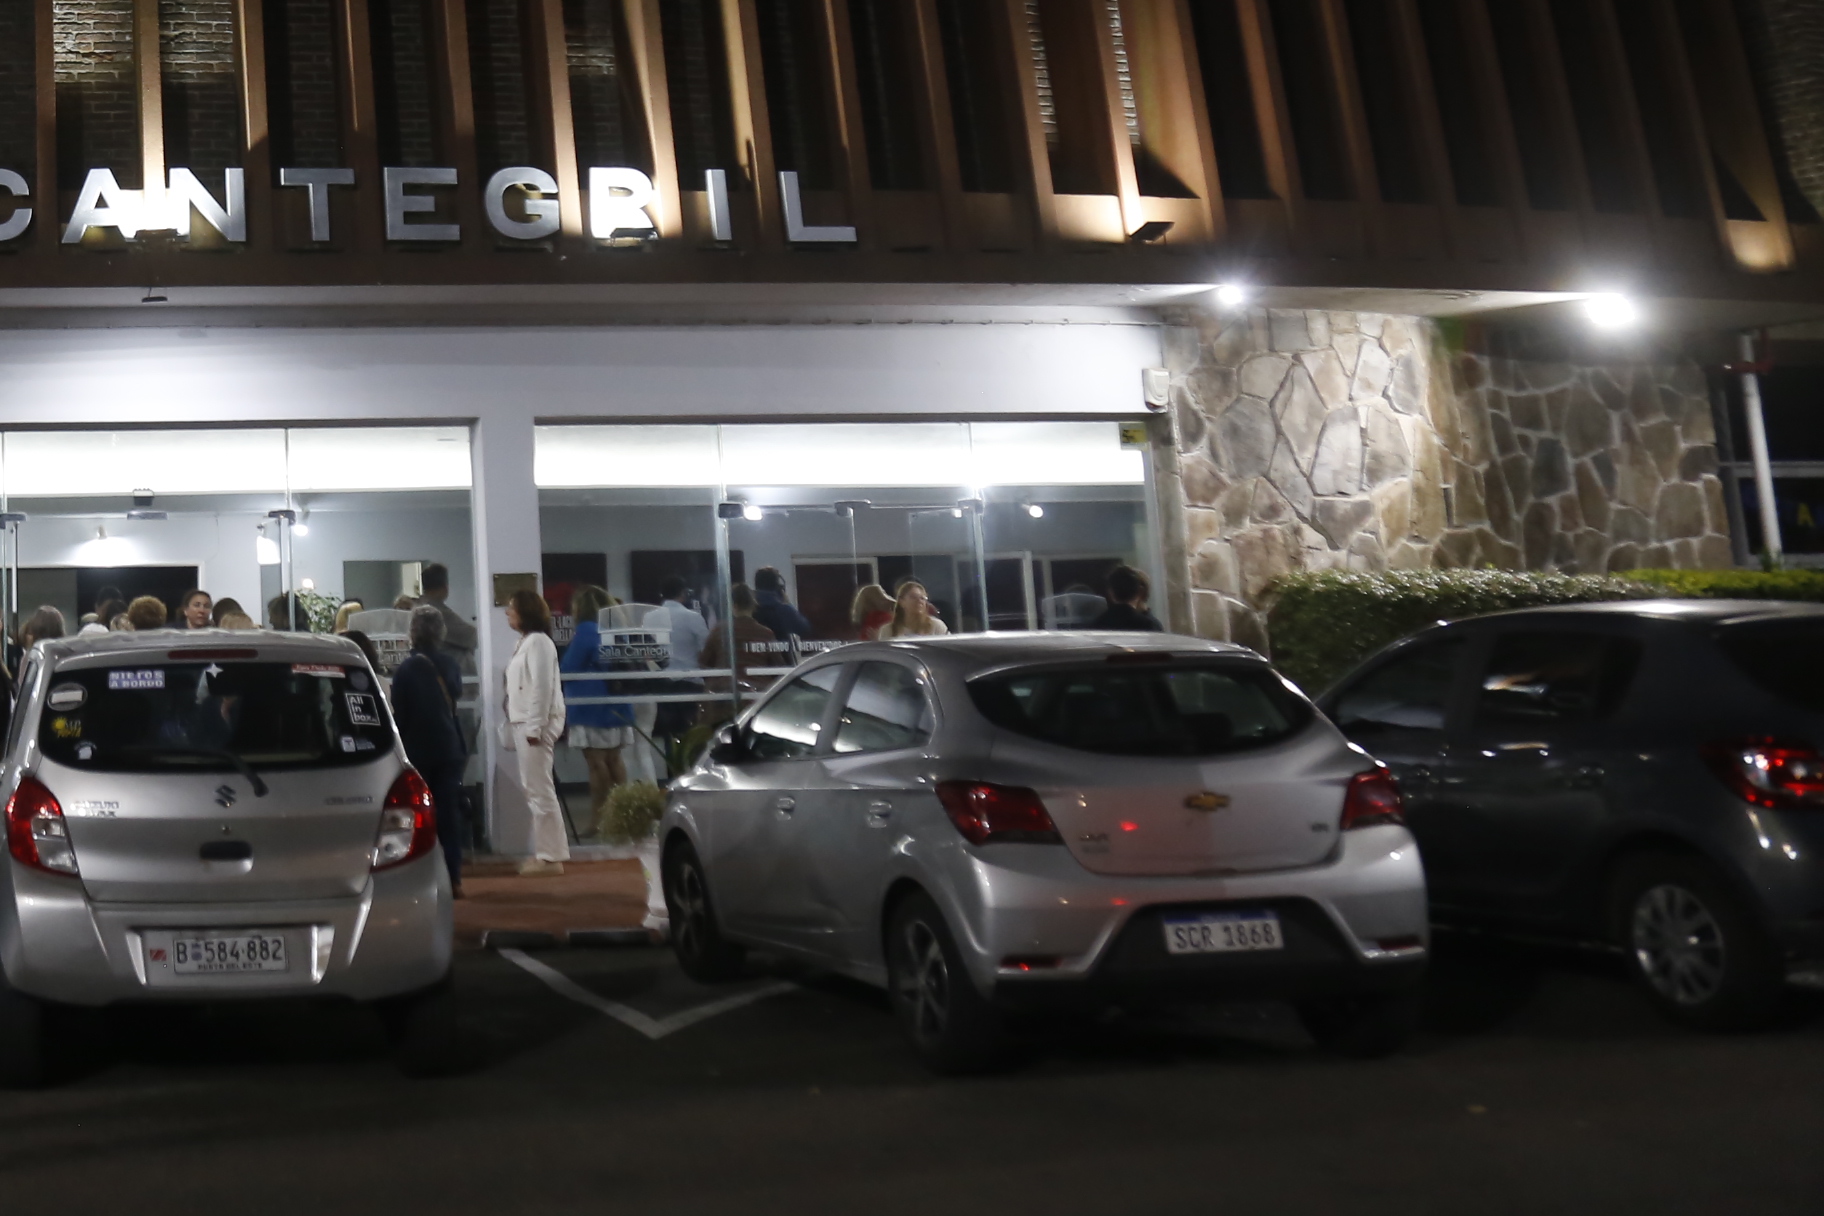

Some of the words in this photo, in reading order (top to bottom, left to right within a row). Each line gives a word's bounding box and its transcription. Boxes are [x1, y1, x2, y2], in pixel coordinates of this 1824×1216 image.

[598, 645, 621, 658] Sala
[111, 670, 164, 680] NIETOS
[350, 695, 364, 705] All
[1175, 925, 1213, 949] SCR
[1223, 923, 1276, 947] 1868
